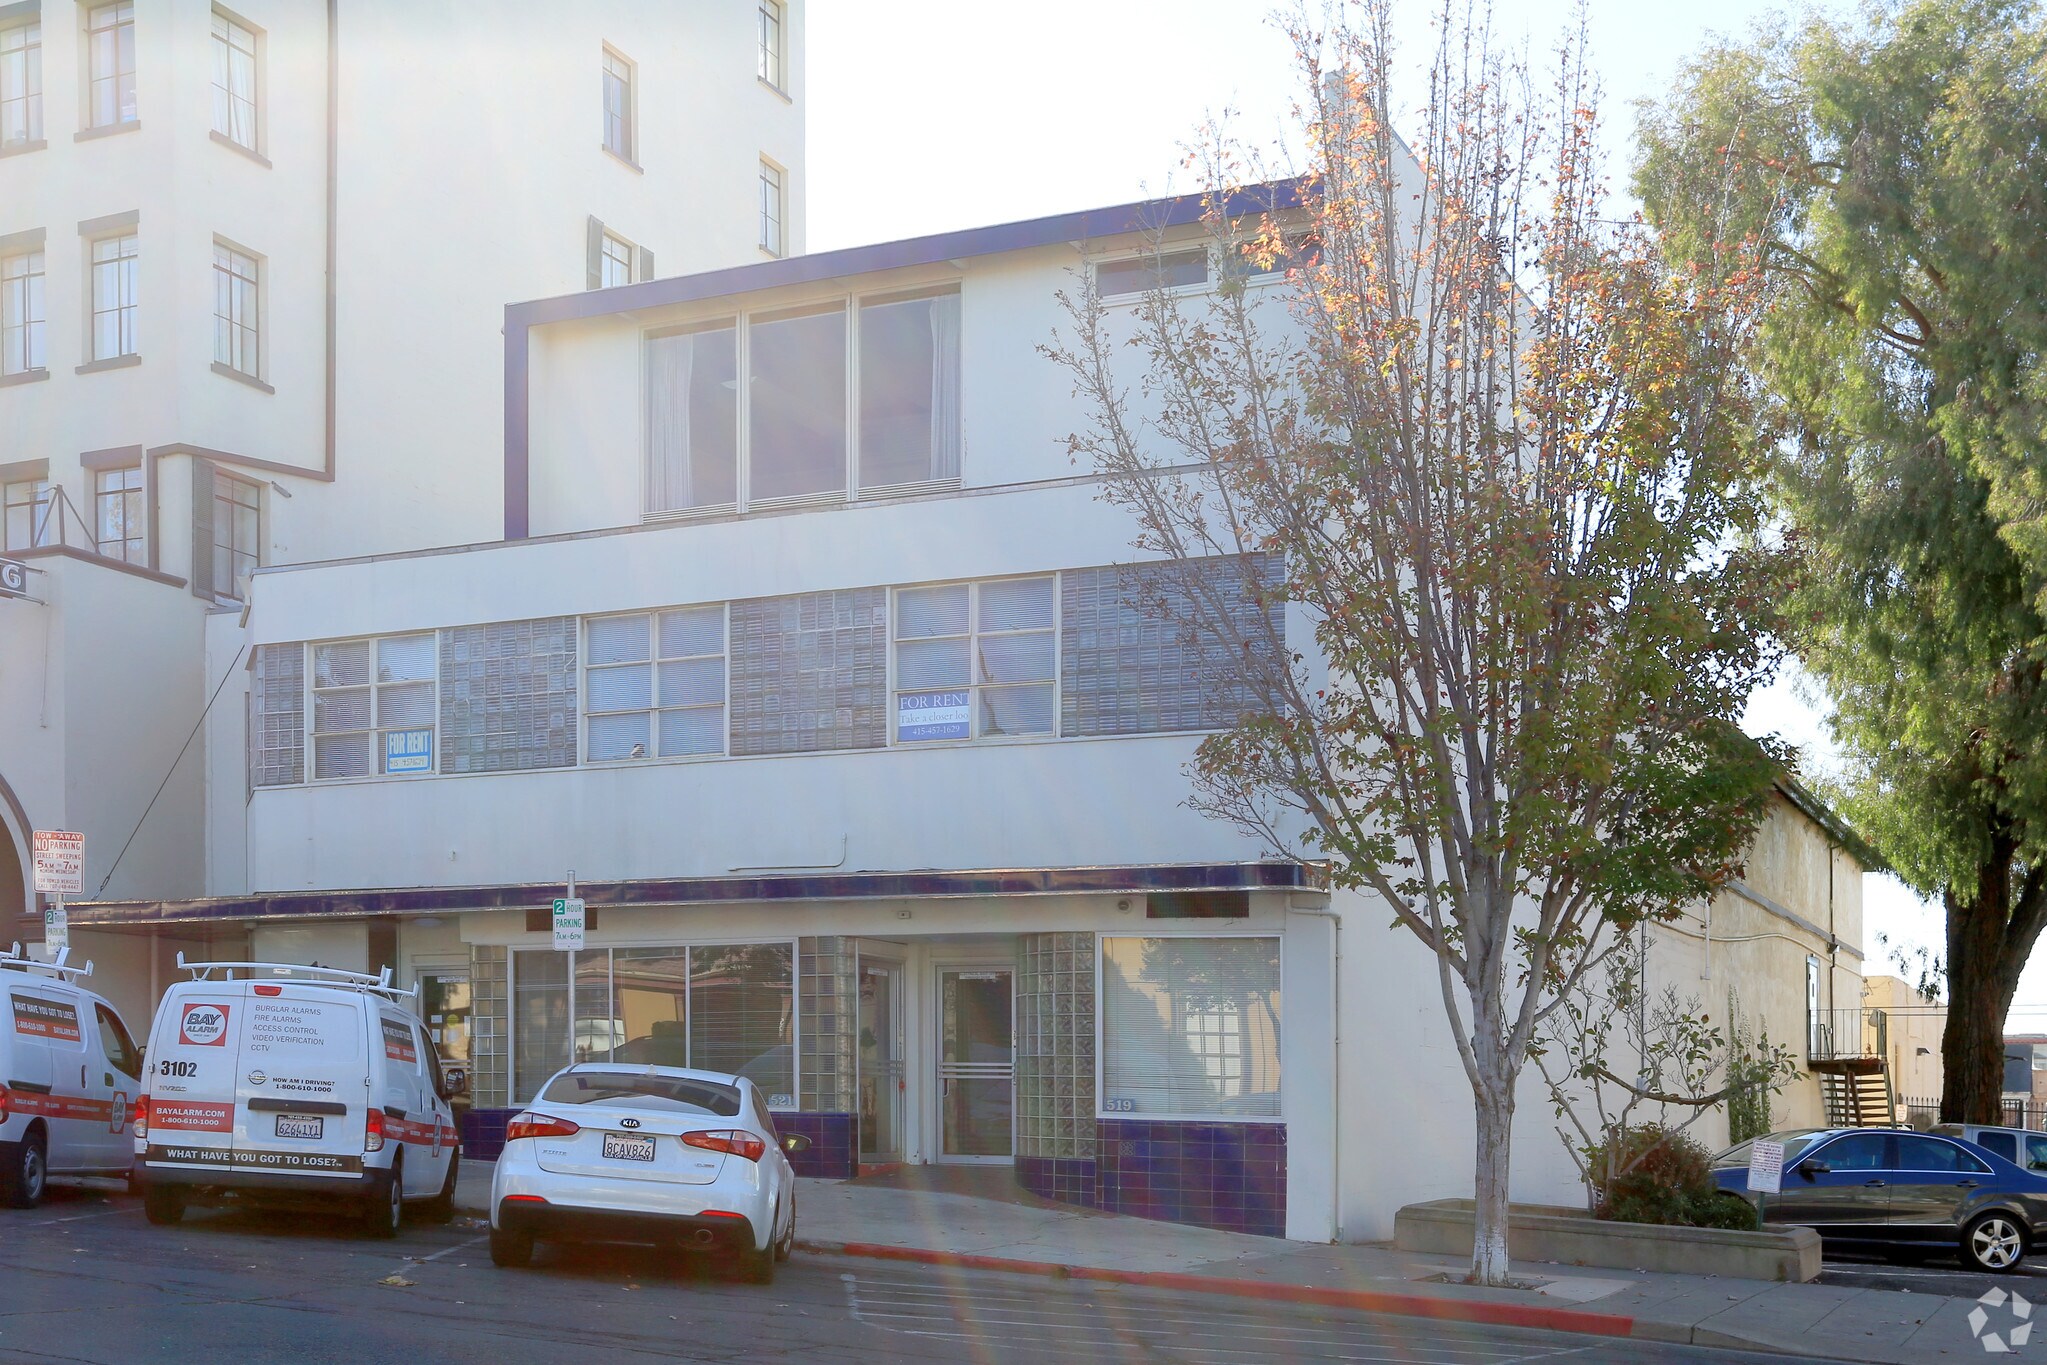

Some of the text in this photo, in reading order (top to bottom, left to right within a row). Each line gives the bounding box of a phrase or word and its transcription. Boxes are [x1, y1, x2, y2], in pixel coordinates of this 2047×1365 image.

[900, 696, 928, 710] FOR
[901, 712, 920, 724] Take
[928, 711, 952, 722] closer
[955, 710, 968, 720] loo
[912, 725, 960, 736] 415-457-1629
[389, 731, 430, 755] FOR RENT
[35, 839, 81, 851] NO PARKING
[55, 853, 81, 861] SWEEPING
[555, 901, 582, 913] 2 HOUR
[46, 912, 53, 923] 2
[555, 918, 582, 929] PARKING
[47, 927, 66, 937] PARKING
[13, 1001, 27, 1012] WHAT
[27, 1003, 39, 1014] HAVE
[39, 1005, 48, 1016] YOU
[255, 1004, 322, 1016] BURGLAR ALARMS
[187, 1012, 222, 1026] BAY
[254, 1014, 302, 1024] FIRE ALARMS
[185, 1025, 220, 1034] ALARM
[252, 1024, 319, 1035] ACCESS CONTROL
[252, 1034, 325, 1046] VIDEO VERIFICATION
[250, 1044, 271, 1052] CCTV
[161, 1060, 198, 1078] 3102
[275, 1084, 332, 1093] 1-800-610-1000
[305, 1079, 336, 1087] DRIVING?
[770, 1095, 792, 1106] 521
[1106, 1099, 1132, 1111] 519
[156, 1107, 226, 1118] BAYALARM.COM
[161, 1117, 220, 1126] 1-800-610-1000
[622, 1119, 638, 1127] KIA
[606, 1142, 652, 1158] 8CAV826
[167, 1149, 199, 1159] WHAT
[201, 1151, 230, 1161] HAVE
[233, 1153, 257, 1162] YOU
[259, 1154, 282, 1164] GOT
[285, 1155, 300, 1165] TO
[303, 1156, 337, 1167] LOSE?
